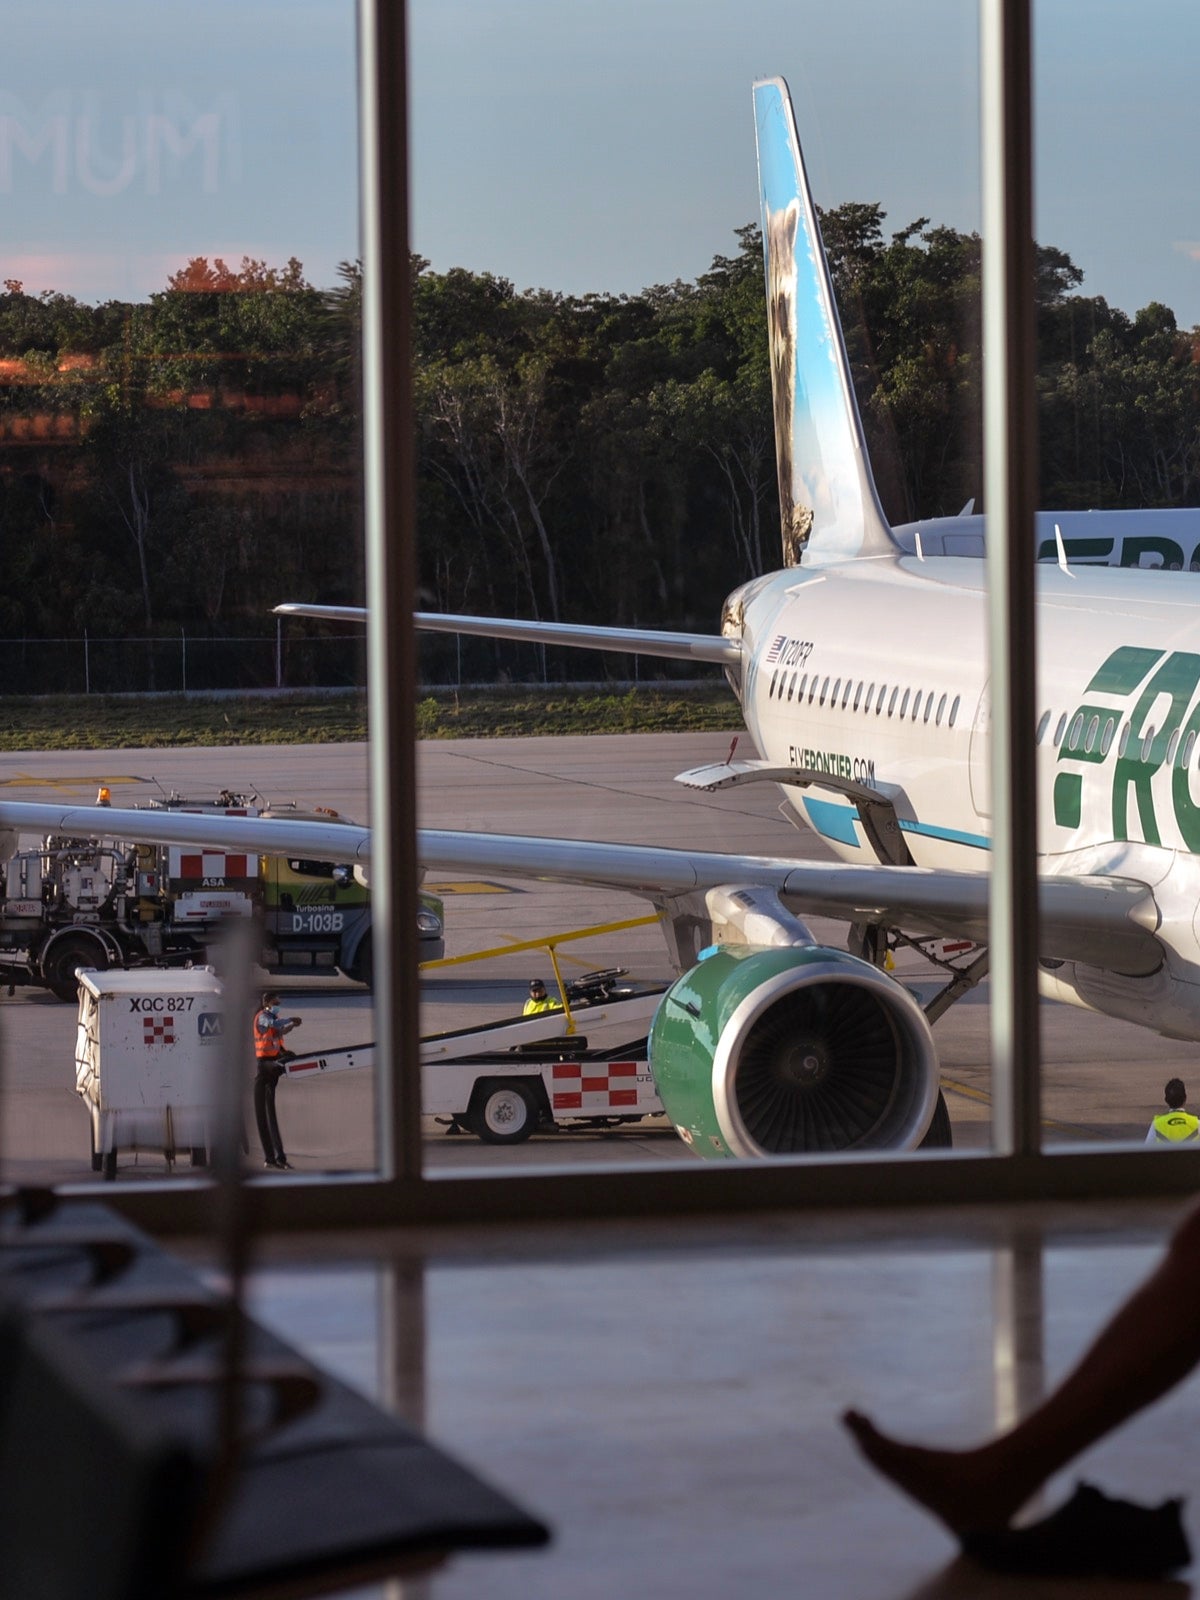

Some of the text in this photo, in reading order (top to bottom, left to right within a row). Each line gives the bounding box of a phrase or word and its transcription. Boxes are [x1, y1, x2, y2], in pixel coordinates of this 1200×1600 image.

[202, 878, 225, 888] ASA
[296, 904, 335, 913] Turbosina
[293, 913, 344, 932] D-103B
[130, 997, 195, 1012] XQC 827
